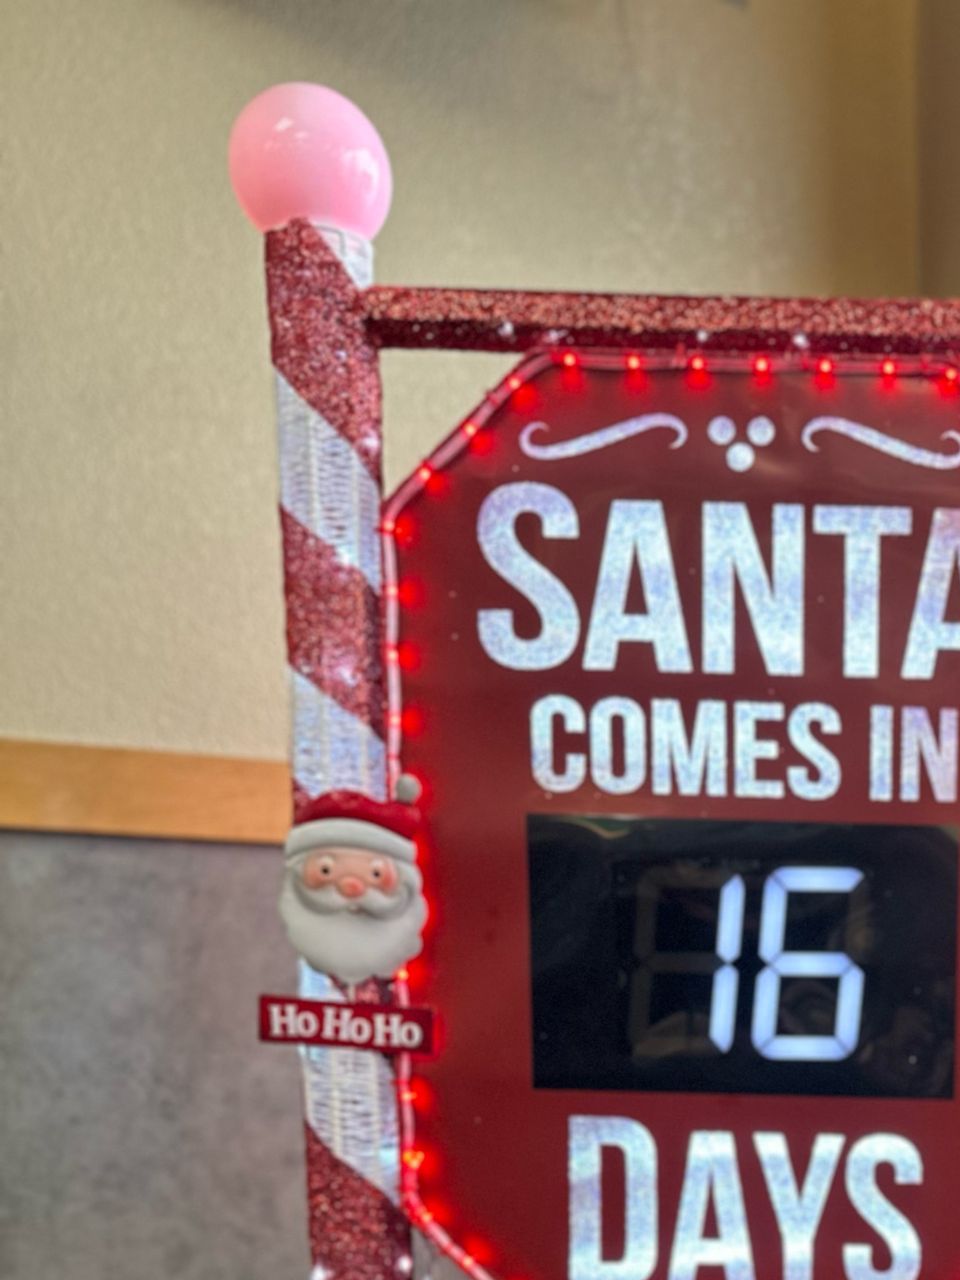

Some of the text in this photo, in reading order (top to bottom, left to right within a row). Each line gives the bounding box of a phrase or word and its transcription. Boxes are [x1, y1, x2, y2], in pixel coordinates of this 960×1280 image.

[529, 694, 959, 803] COMES IN
[708, 866, 866, 1061] 16
[268, 1003, 423, 1047] Ho Ho Ho
